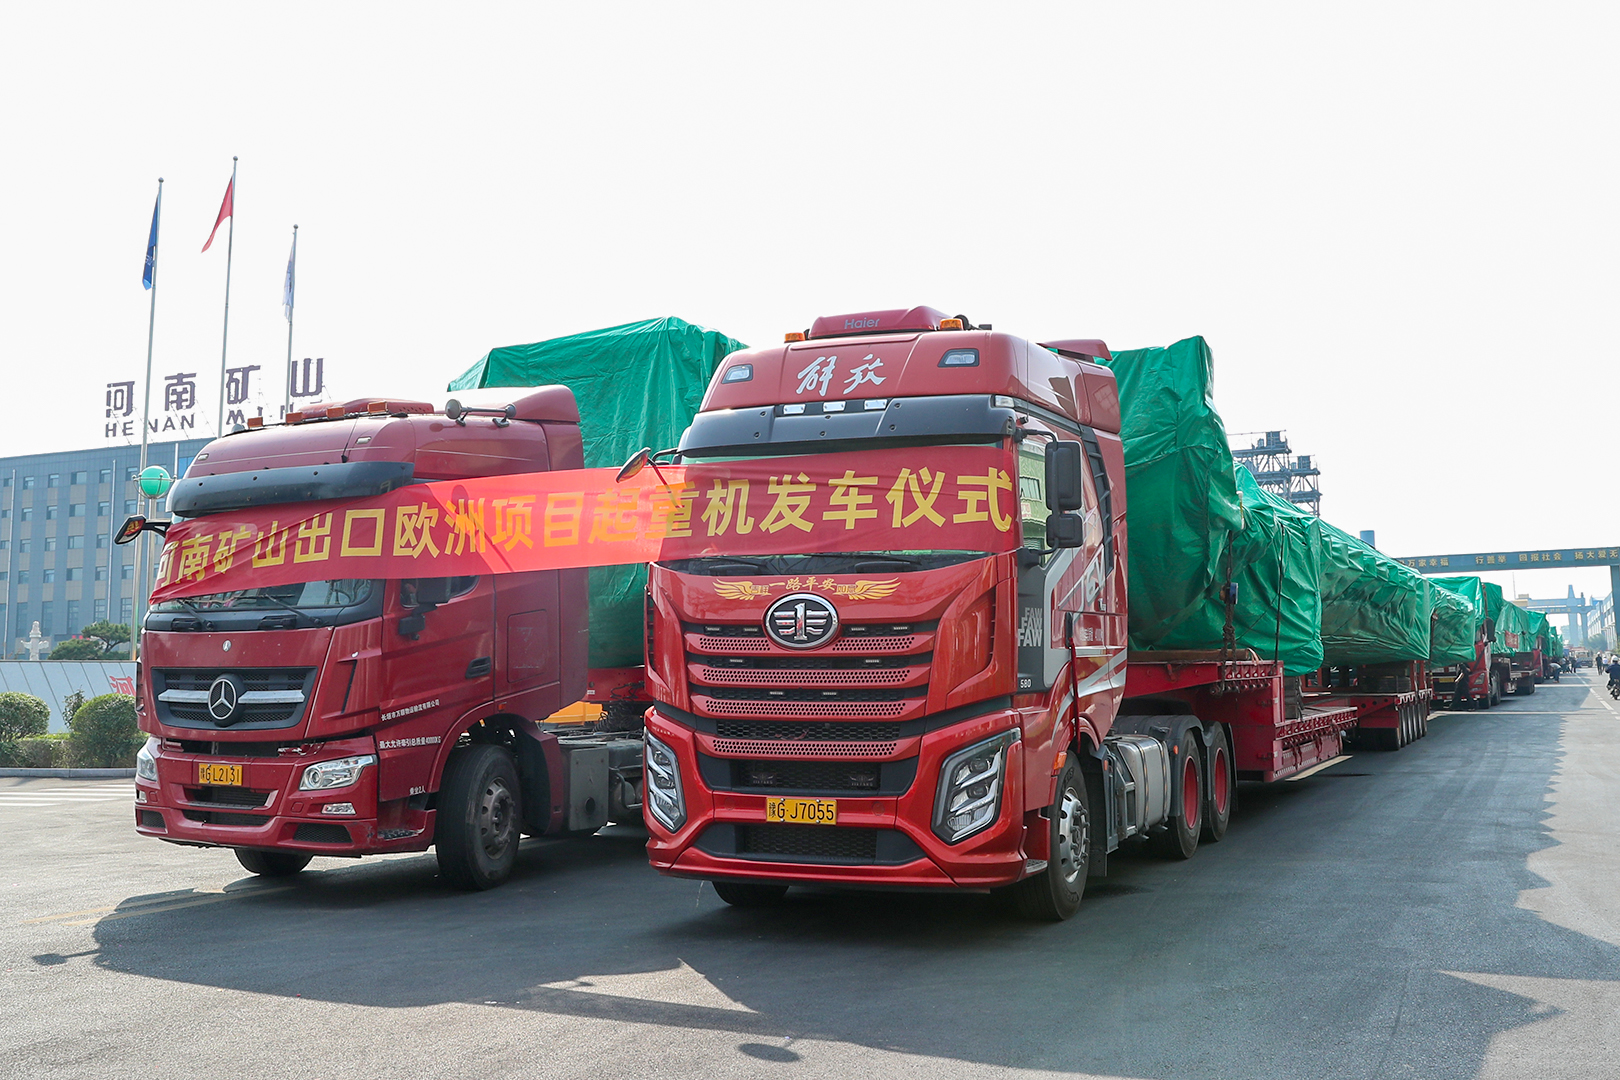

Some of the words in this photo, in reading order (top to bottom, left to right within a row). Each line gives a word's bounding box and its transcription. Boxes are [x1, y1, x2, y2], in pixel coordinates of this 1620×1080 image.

[844, 317, 880, 330] Haier
[106, 358, 324, 418] 河南矿山
[105, 413, 195, 438] HENAN
[1400, 558, 1449, 567] 万家幸福
[1519, 552, 1562, 562] 回报社会
[769, 576, 838, 591] 一路平安
[1025, 607, 1043, 618] FAW
[1021, 617, 1043, 630] FAW
[1018, 628, 1043, 647] FAW
[1020, 679, 1032, 688] 580
